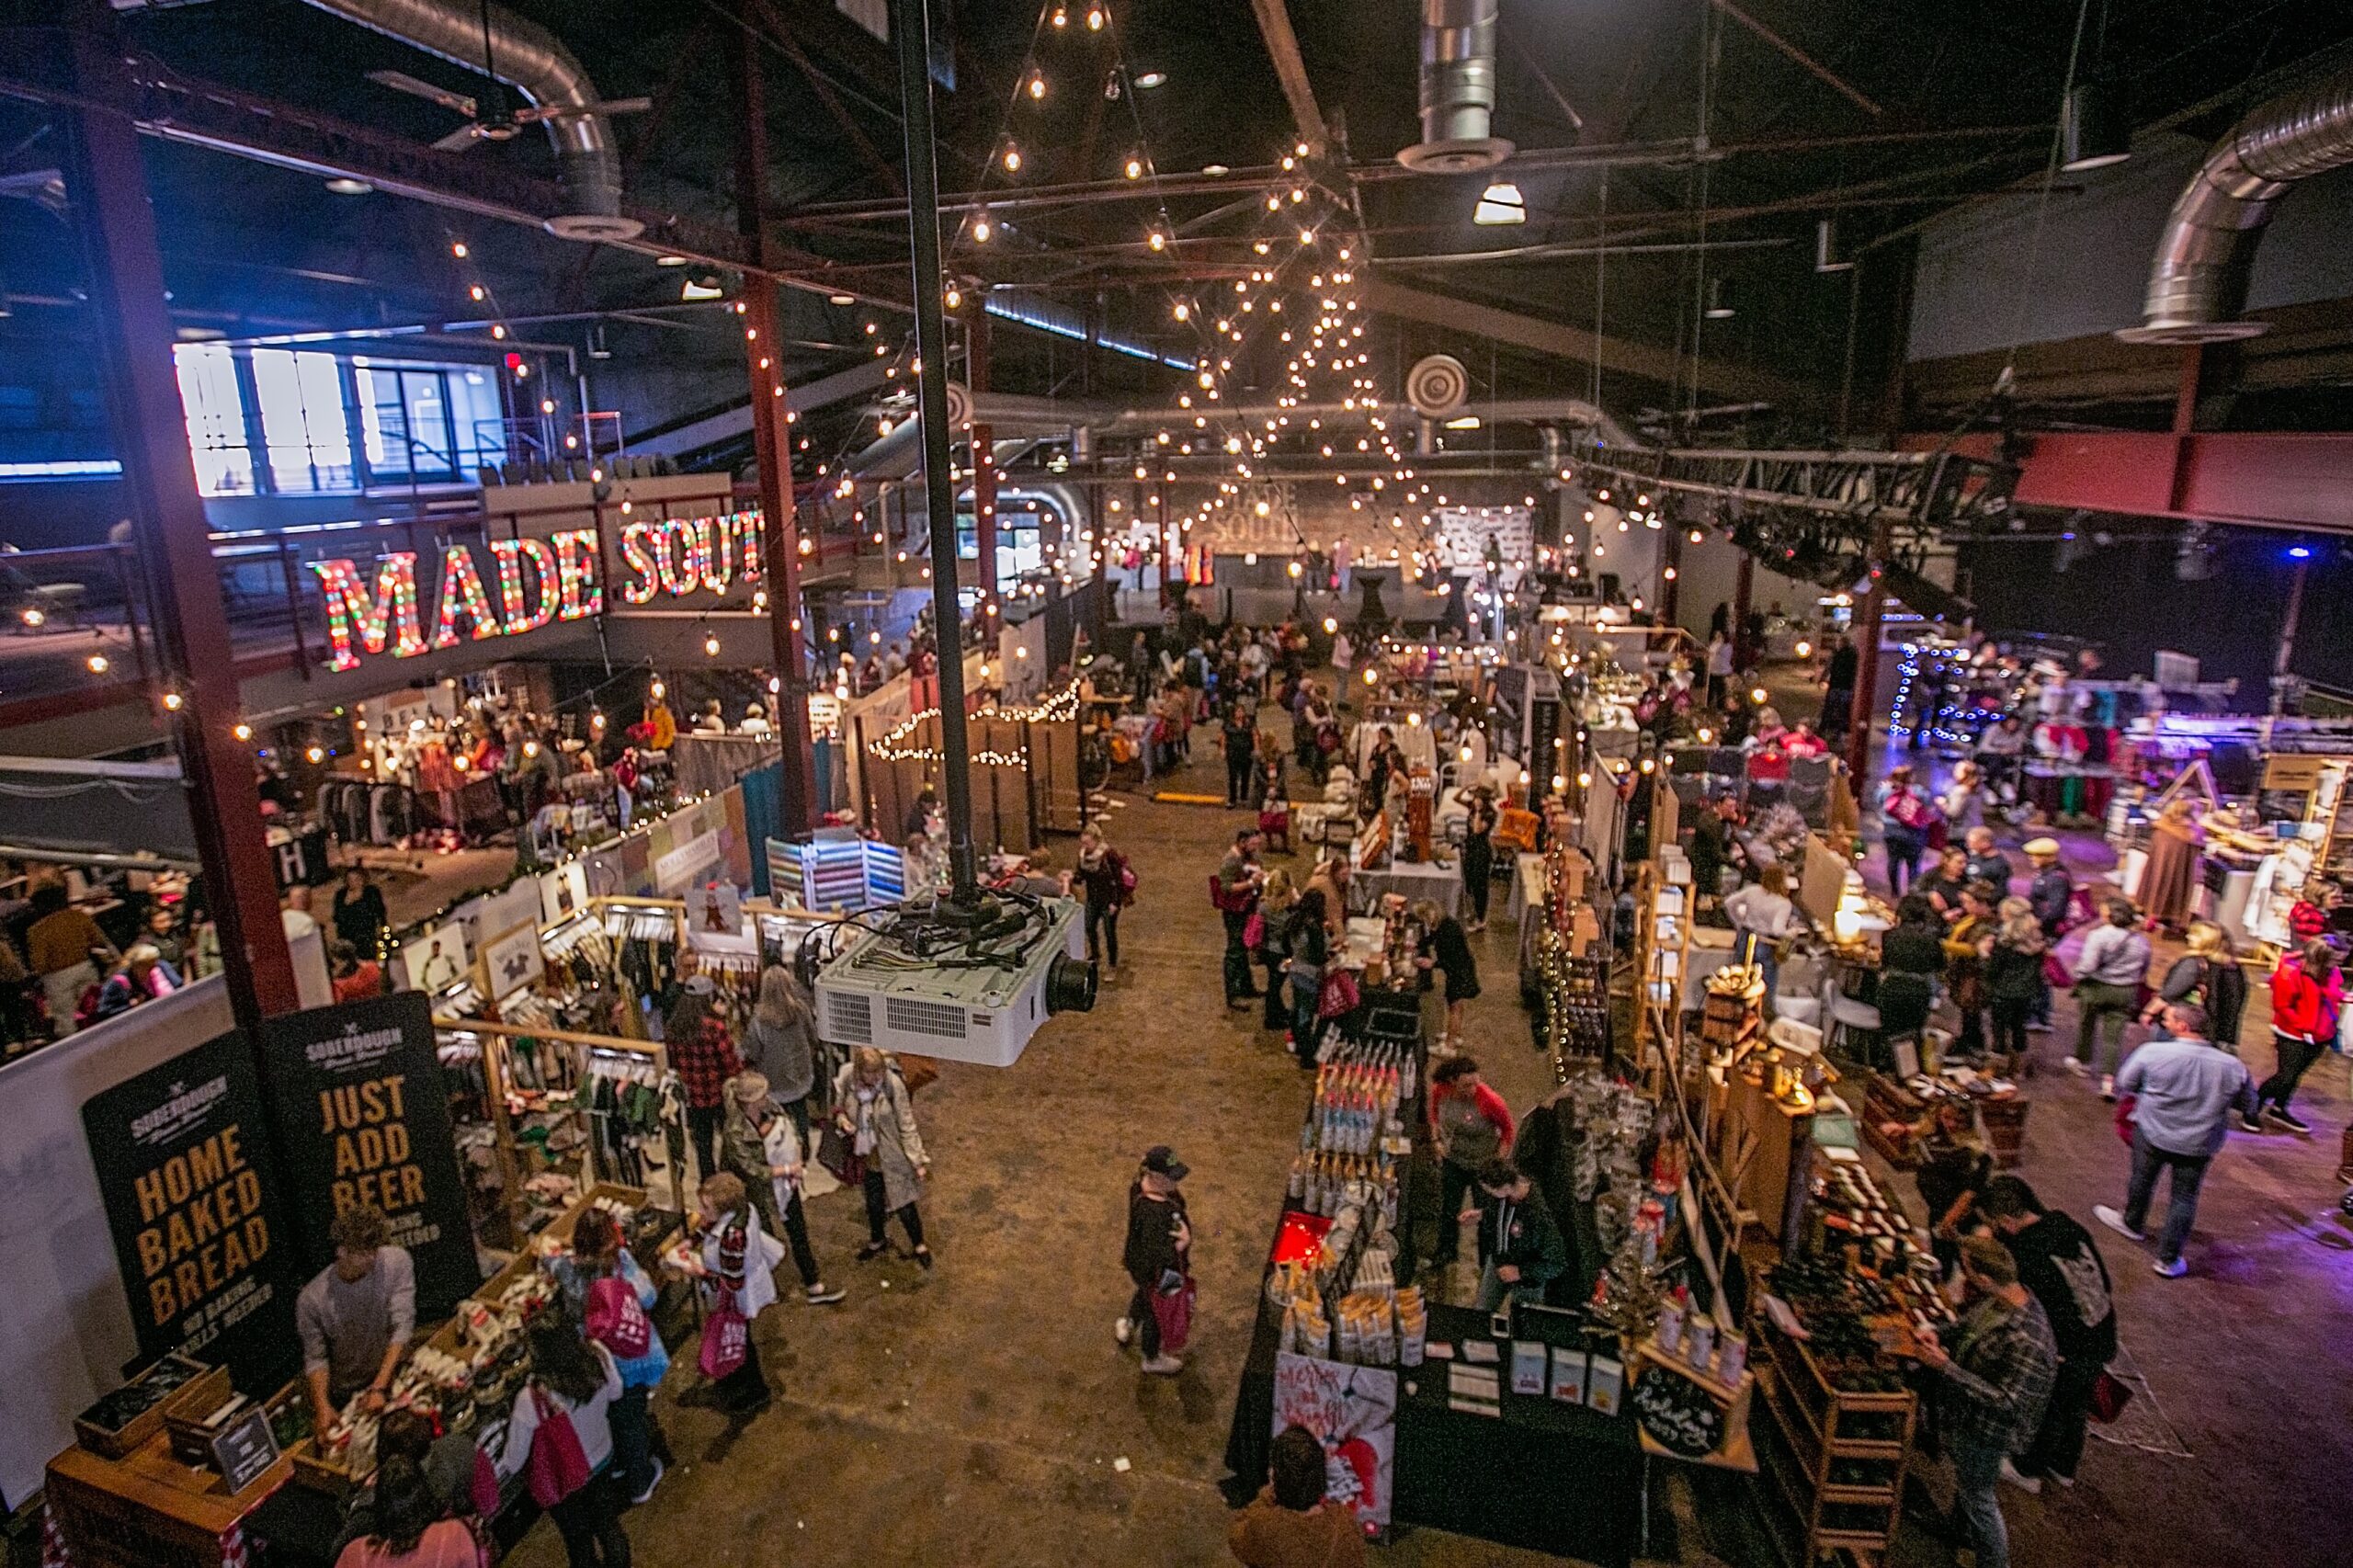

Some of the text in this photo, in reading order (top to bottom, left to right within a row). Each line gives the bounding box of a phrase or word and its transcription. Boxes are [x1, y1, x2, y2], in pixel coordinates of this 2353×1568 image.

[313, 509, 766, 673] MADE SOUT
[305, 1027, 403, 1062] SOBERDOUGH
[318, 1074, 405, 1134] JUST
[134, 1123, 245, 1223] HOME
[334, 1122, 411, 1177] ADD
[137, 1168, 262, 1278] BAKED
[330, 1165, 427, 1222] BEER
[149, 1214, 270, 1327] BREAD
